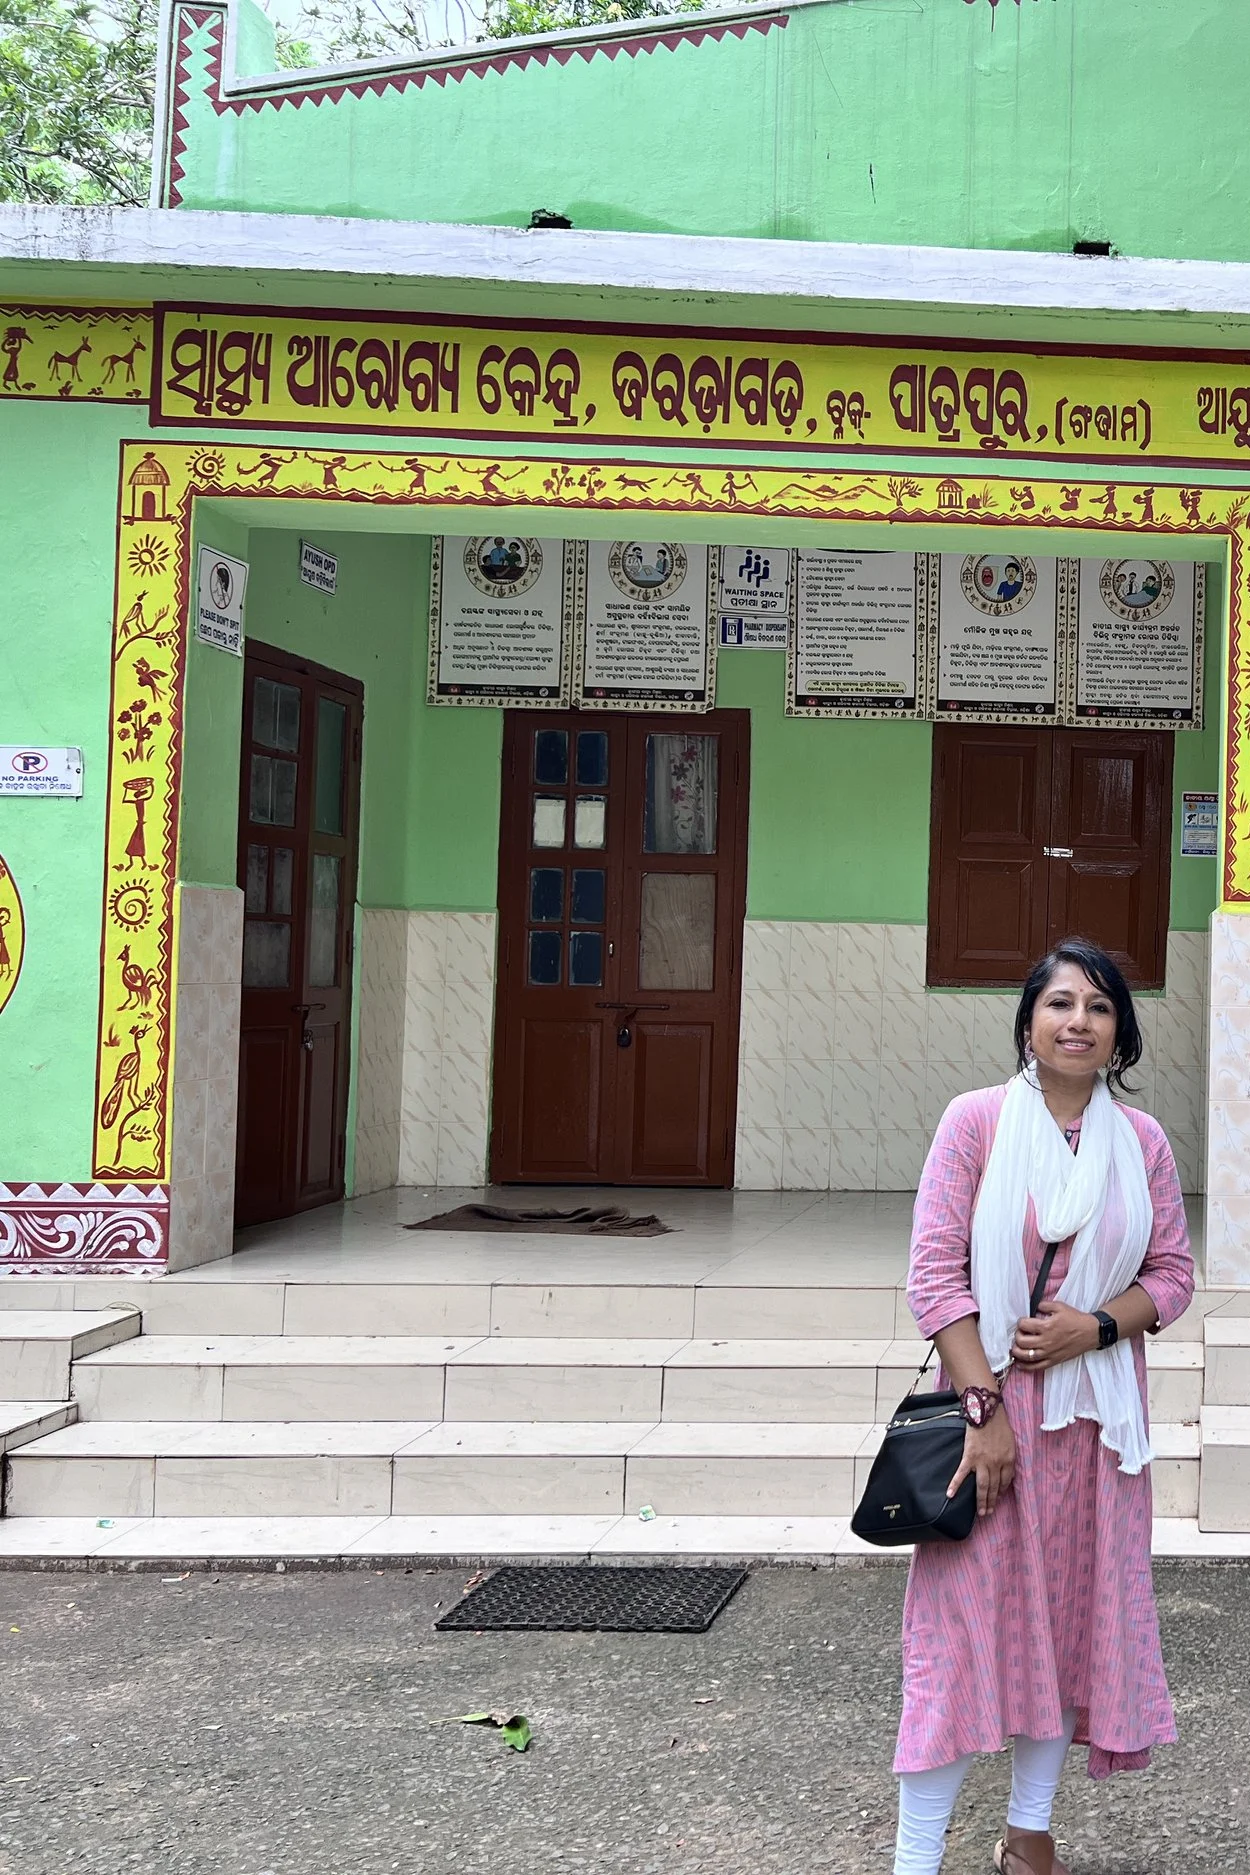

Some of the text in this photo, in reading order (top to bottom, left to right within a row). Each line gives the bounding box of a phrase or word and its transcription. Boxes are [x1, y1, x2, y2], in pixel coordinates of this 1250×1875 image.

[286, 334, 461, 413] ଆରୋଗ୍ୟ
[304, 549, 335, 573] AYUSH OPD
[200, 608, 216, 622] PLEASE
[230, 620, 239, 630] SPIT
